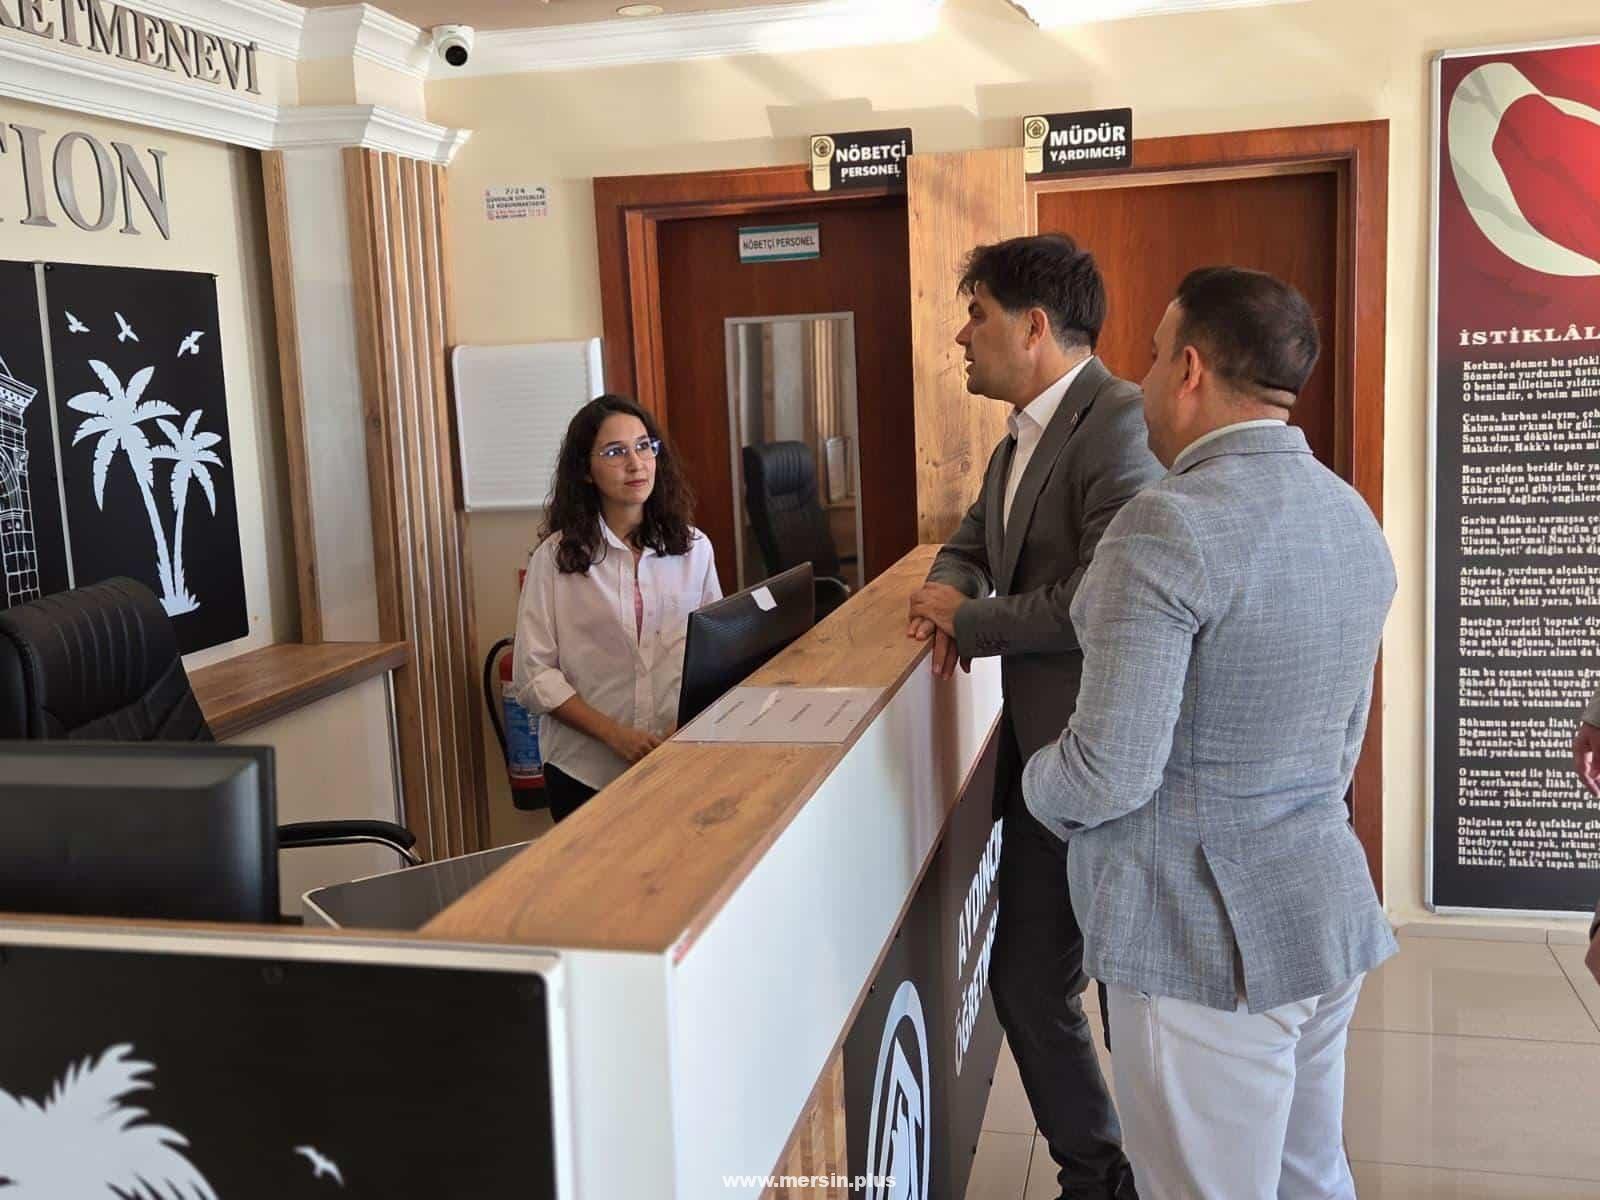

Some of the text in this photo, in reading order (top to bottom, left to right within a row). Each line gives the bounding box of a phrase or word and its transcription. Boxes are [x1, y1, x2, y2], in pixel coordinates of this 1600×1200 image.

[0, 0, 262, 95] ETMENEVİ
[1049, 122, 1126, 147] MÜDÜR
[835, 140, 906, 163] NÖBETÇİ
[840, 163, 901, 182] PERSONEL
[743, 235, 816, 250] NÖBETÇİ PERSONEL
[1463, 382, 1471, 391] O
[1463, 392, 1471, 402] O
[1459, 768, 1466, 776] O
[1459, 798, 1466, 806] O
